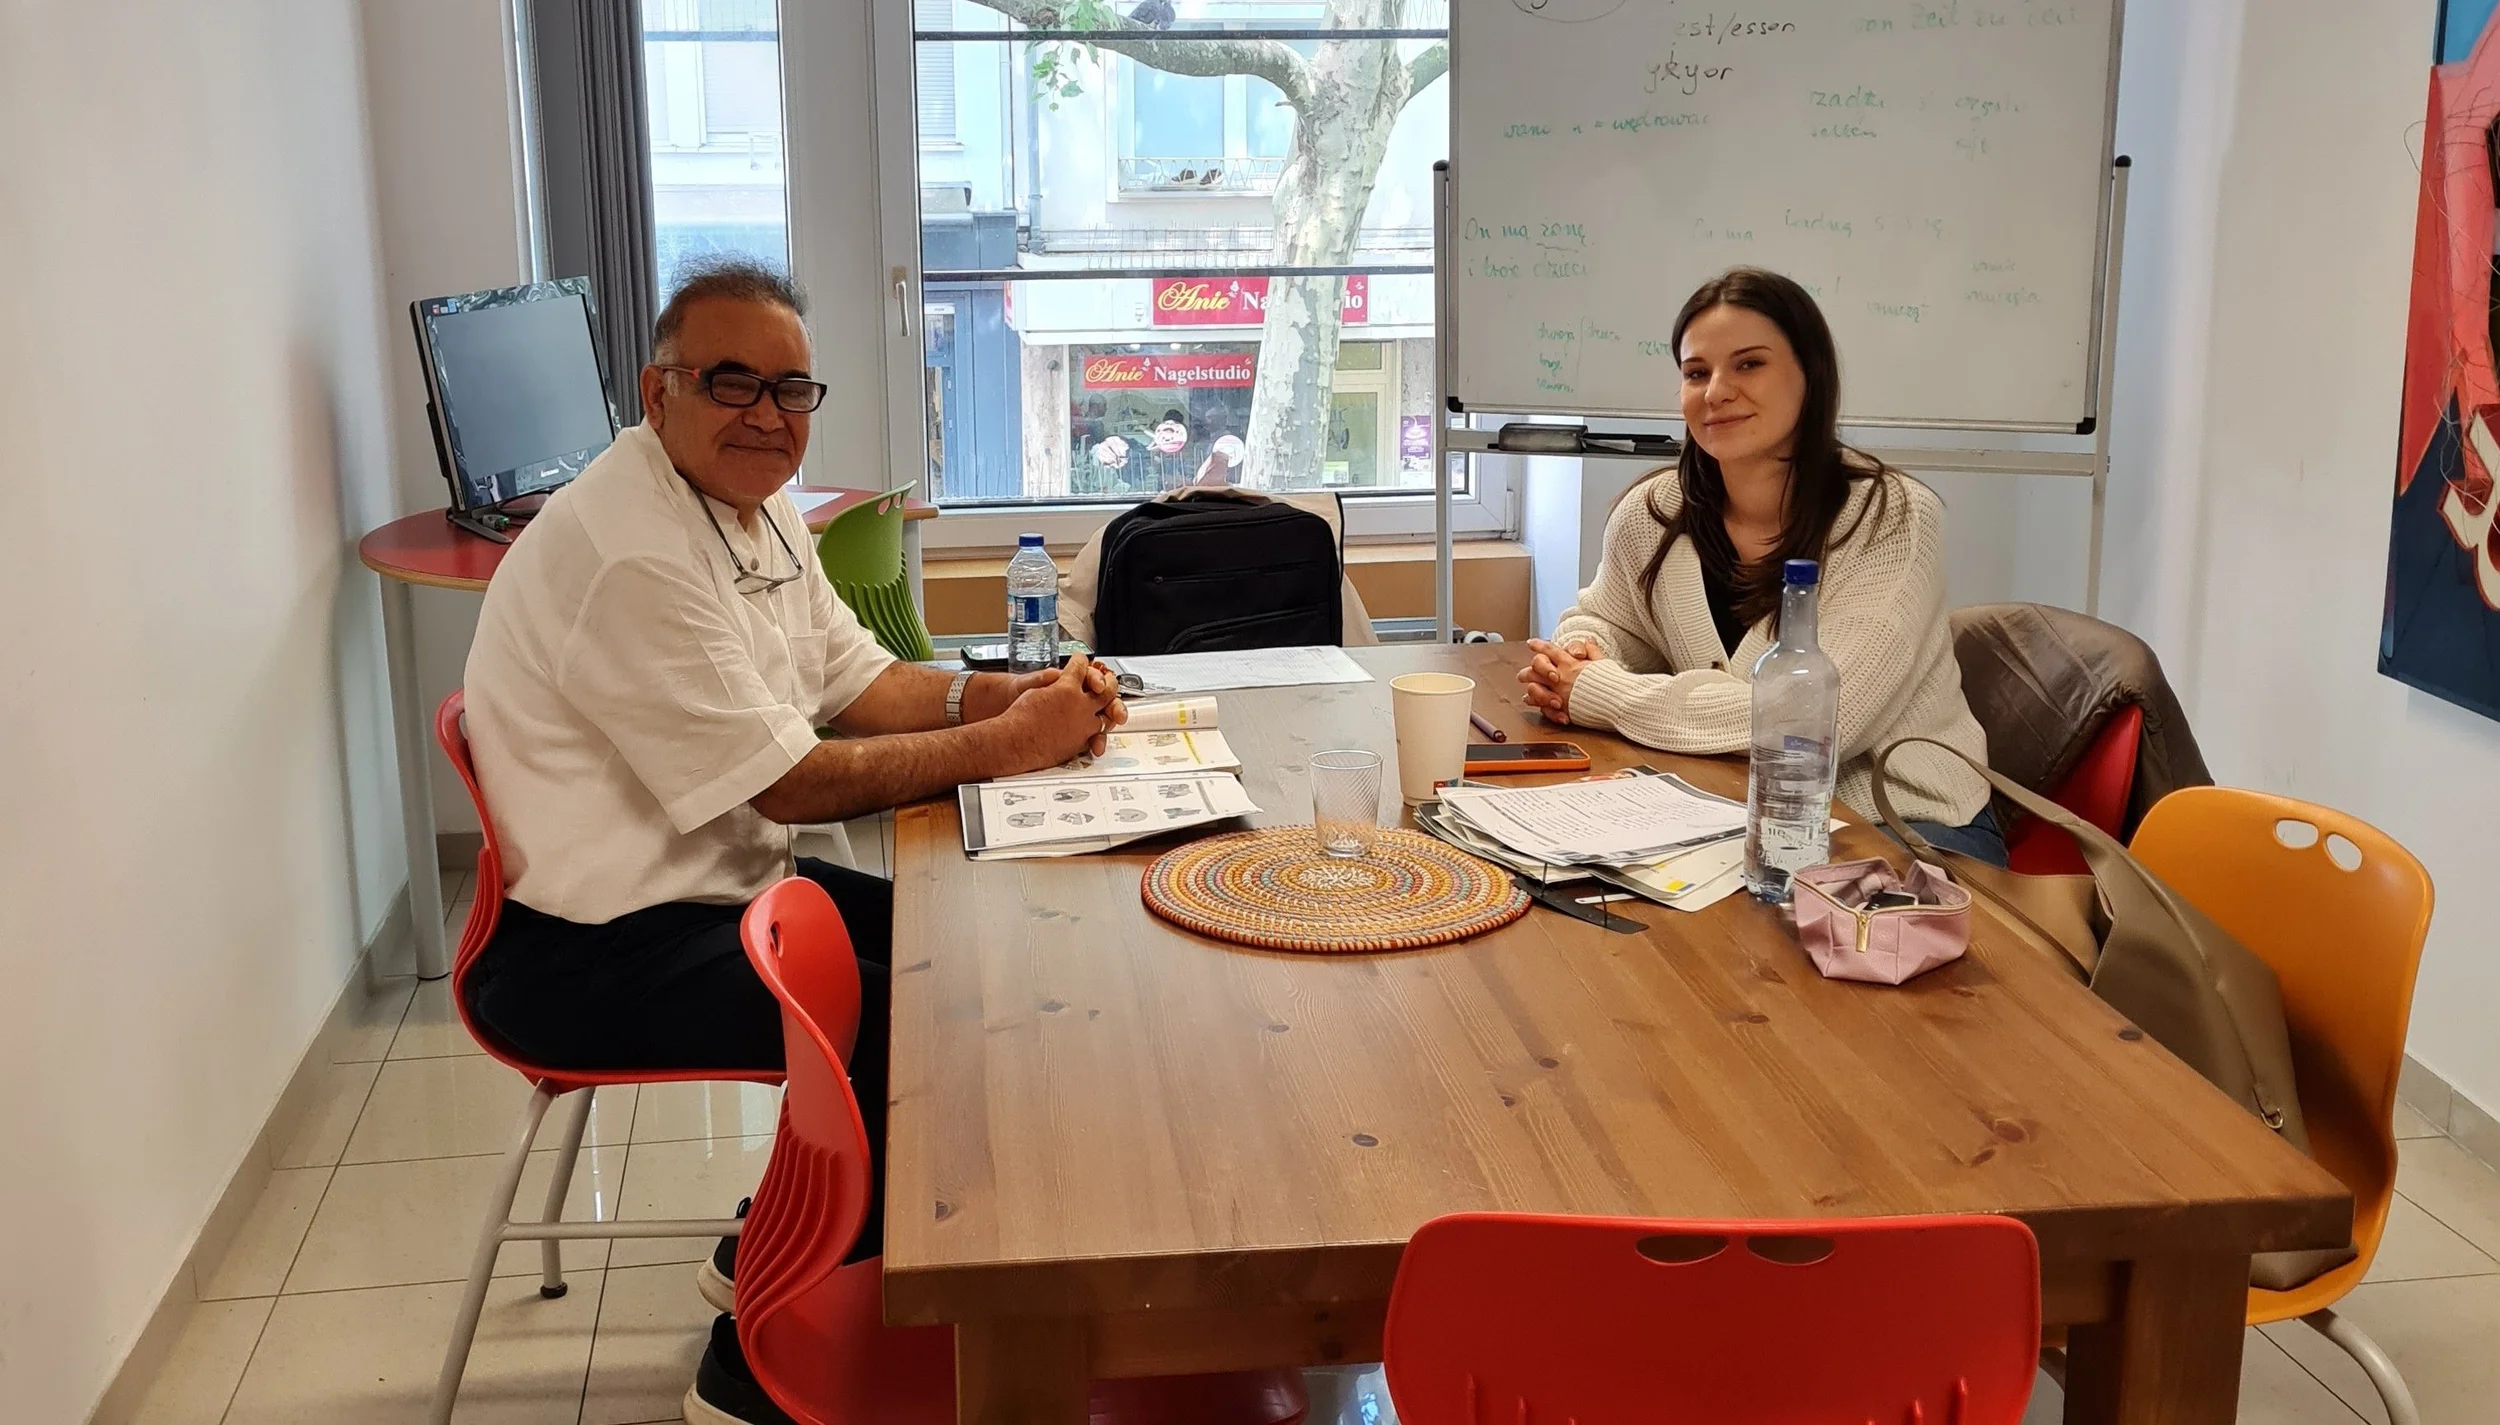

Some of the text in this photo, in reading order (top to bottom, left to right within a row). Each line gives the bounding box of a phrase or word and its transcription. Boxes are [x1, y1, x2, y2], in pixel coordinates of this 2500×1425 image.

[1158, 281, 1231, 311] Anie
[1085, 359, 1251, 385] Anie Nagelstudio
